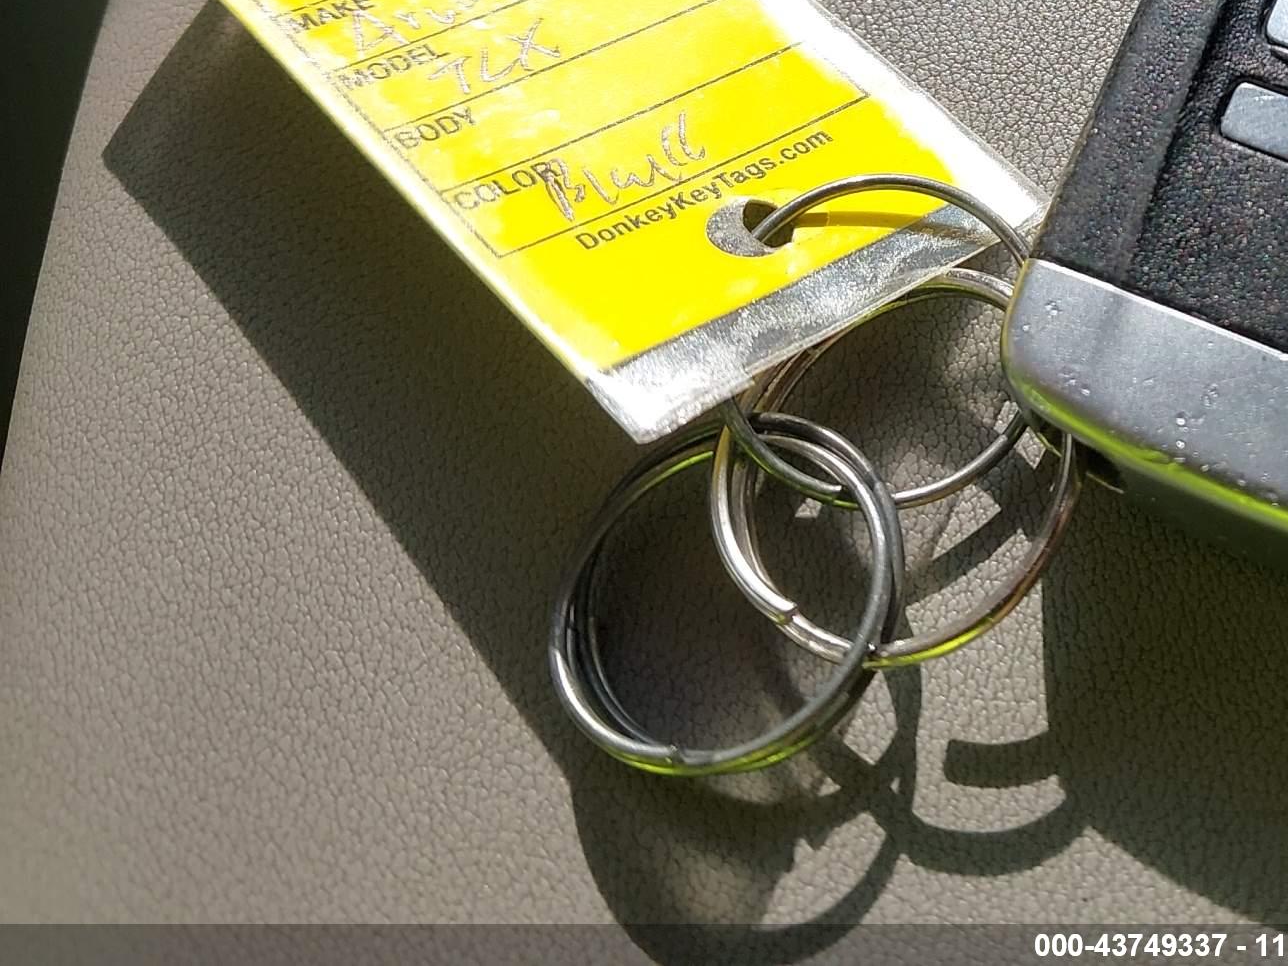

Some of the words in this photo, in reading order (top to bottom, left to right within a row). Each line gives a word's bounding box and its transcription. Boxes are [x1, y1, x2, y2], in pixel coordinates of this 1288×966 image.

[336, 42, 451, 91] MODEL
[427, 17, 561, 95] TLX
[393, 106, 477, 151] BODY
[453, 159, 561, 212] COLOR
[575, 128, 834, 251] DonkeyKeyTags.com
